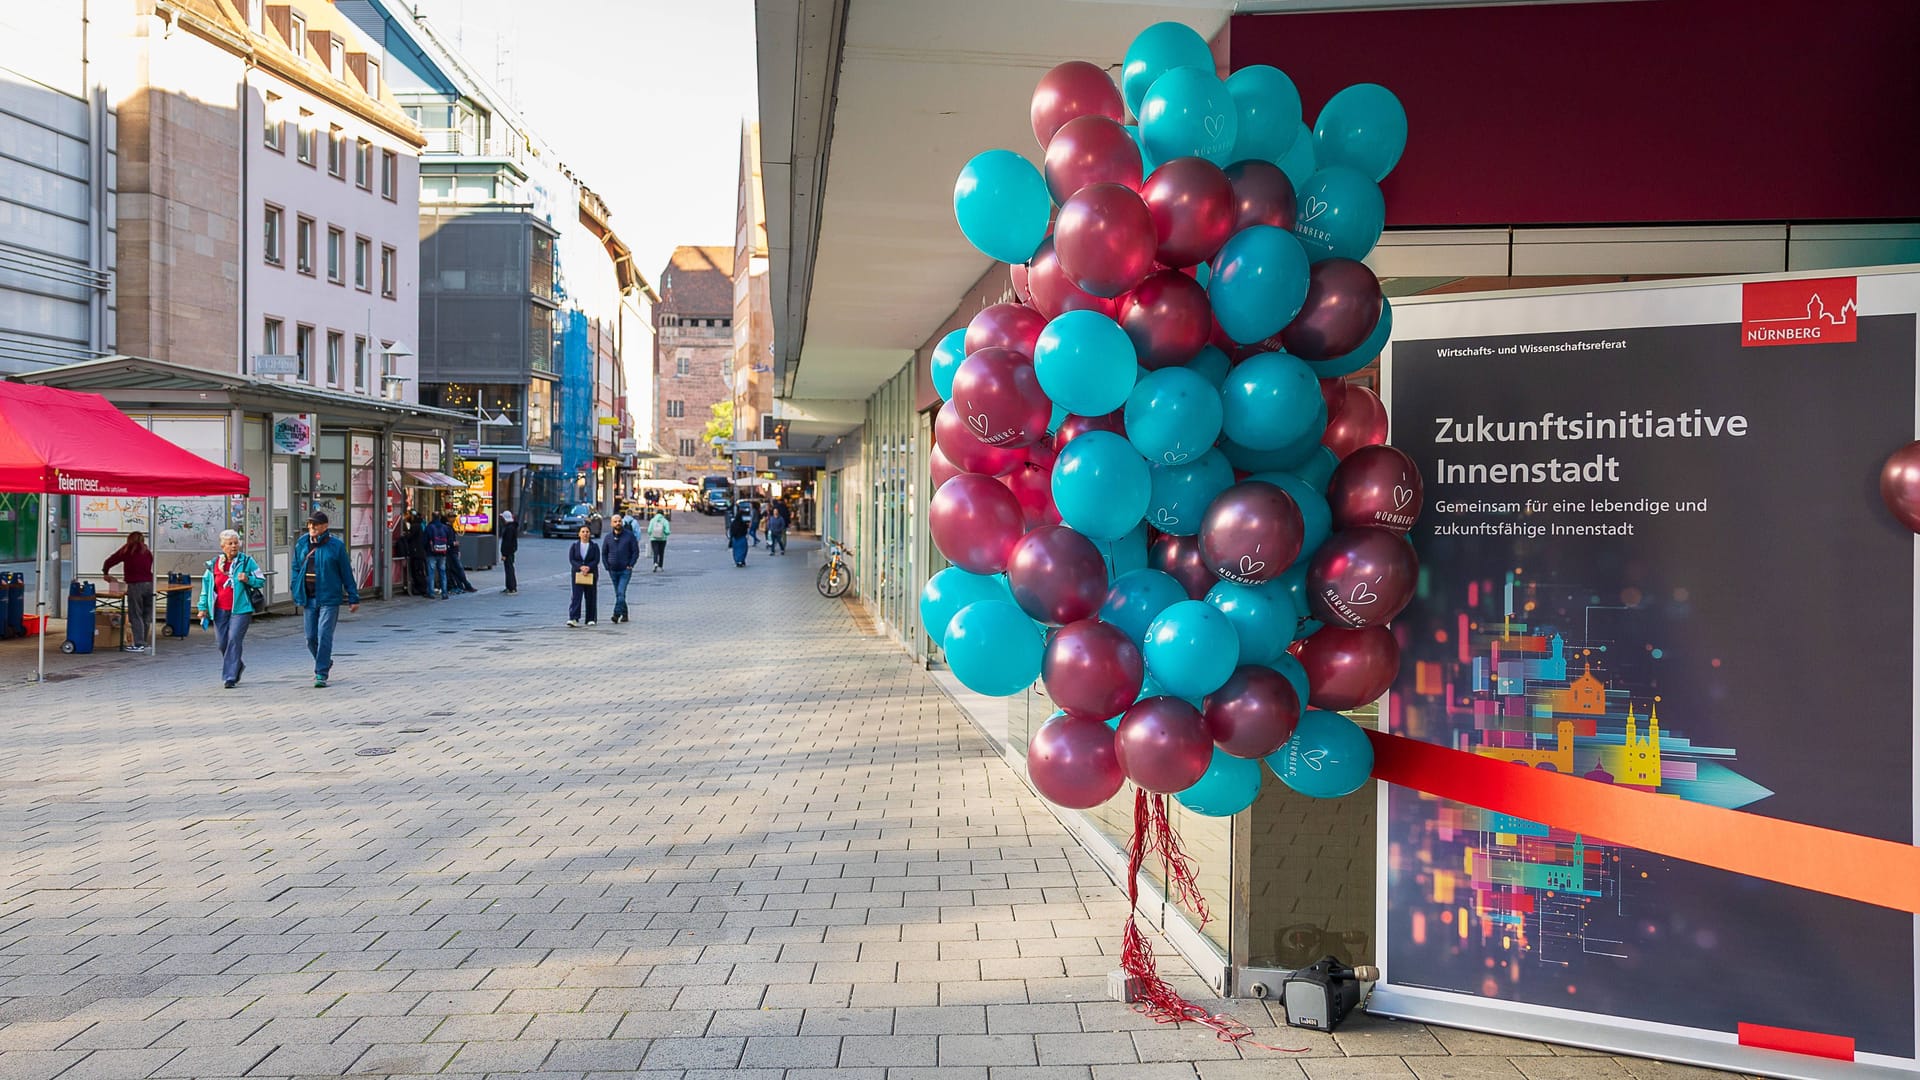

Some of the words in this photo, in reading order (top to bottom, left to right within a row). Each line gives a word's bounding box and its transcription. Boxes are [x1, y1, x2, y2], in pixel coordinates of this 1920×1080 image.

[1294, 221, 1331, 242] ÜRNBERG
[1747, 327, 1820, 341] NÜRNBERG
[1436, 347, 1496, 358] Wirtschafts-
[1498, 345, 1517, 355] und
[1519, 339, 1627, 354] Wissenschaftsreferat
[1434, 409, 1748, 443] Zukunftsinitiative
[1437, 454, 1620, 484] Innenstadt
[1435, 500, 1521, 514] Gemeinsam
[1525, 500, 1548, 513] für
[1552, 500, 1586, 513] eine
[1590, 499, 1670, 515] lebendige
[1675, 499, 1708, 513] und
[1434, 523, 1546, 538] zukunftsfähige
[1551, 521, 1635, 536] Innenstadt
